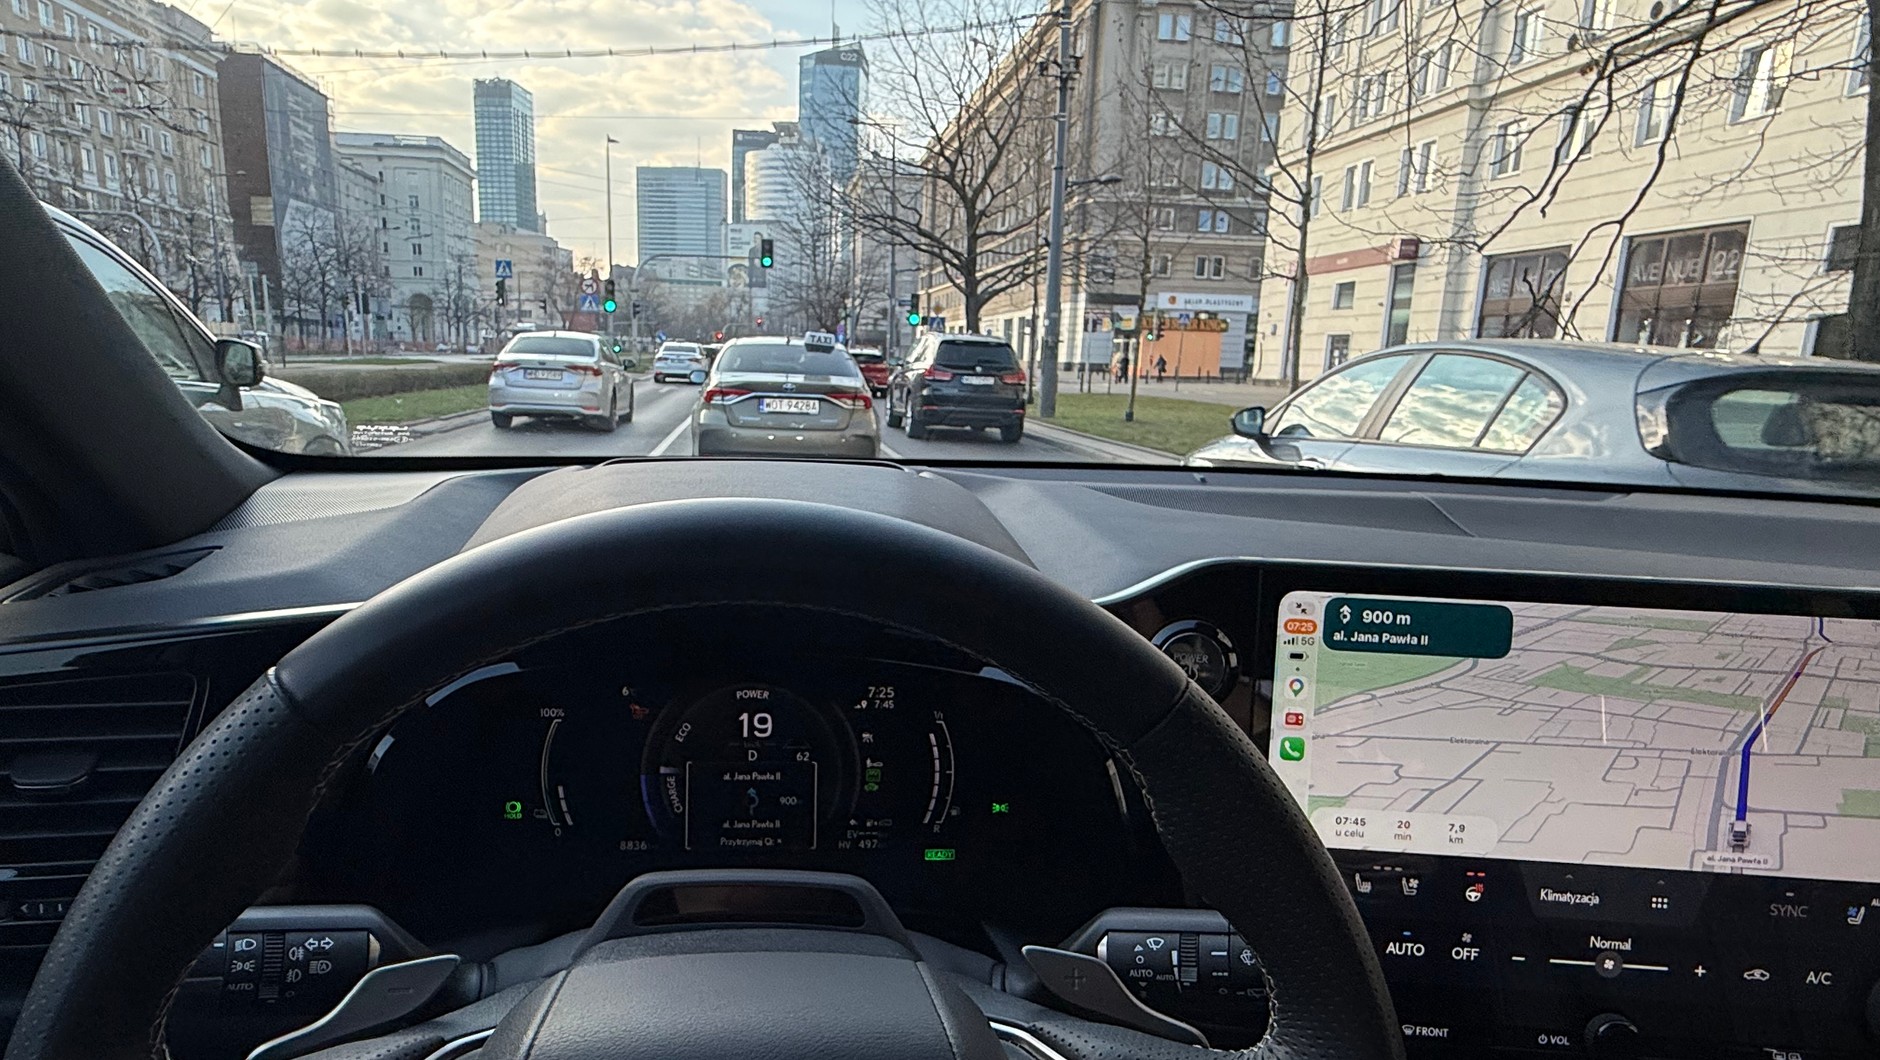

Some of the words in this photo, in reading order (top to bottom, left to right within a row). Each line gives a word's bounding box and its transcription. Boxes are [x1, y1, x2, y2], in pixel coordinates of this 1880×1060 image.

[1711, 250, 1740, 275] 22
[809, 335, 832, 344] TAXI
[765, 400, 783, 410] WOT
[1362, 610, 1393, 624] 900
[1395, 614, 1411, 625] m
[1287, 621, 1314, 632] 07:25
[1301, 637, 1315, 646] 5G
[1333, 630, 1348, 641] al.
[1350, 631, 1379, 643] Jana
[1382, 632, 1413, 645] Pawła
[1420, 634, 1429, 645] II
[1173, 651, 1209, 664] POWER
[736, 690, 770, 700] POWER
[868, 686, 895, 698] 7:25
[874, 699, 895, 709] 7:45
[540, 707, 565, 717] 100%
[738, 712, 772, 738] 19
[674, 722, 692, 743] ECO
[748, 749, 758, 761] D
[796, 751, 811, 761] 62
[733, 772, 750, 780] Jana
[666, 775, 684, 814] CHARGE
[780, 796, 798, 805] 900
[1335, 816, 1366, 827] 07:45
[1396, 820, 1411, 830] 20
[933, 824, 941, 833] R
[1344, 829, 1365, 838] celu
[1448, 823, 1466, 834] 7,9
[1394, 832, 1412, 841] min
[1448, 835, 1464, 844] km
[858, 839, 879, 848] 497
[926, 851, 953, 859] READY
[1540, 888, 1600, 906] Klimatyzacja
[1770, 903, 1809, 917] SYNC
[1590, 935, 1632, 951] Normal
[1385, 942, 1426, 957] AUTO
[1451, 947, 1480, 960] OFF
[1129, 968, 1154, 978] AUTO
[1805, 970, 1833, 985] A/C
[226, 982, 254, 990] AUTO
[1416, 1026, 1450, 1038] FRONT
[1549, 1034, 1571, 1046] VOL
